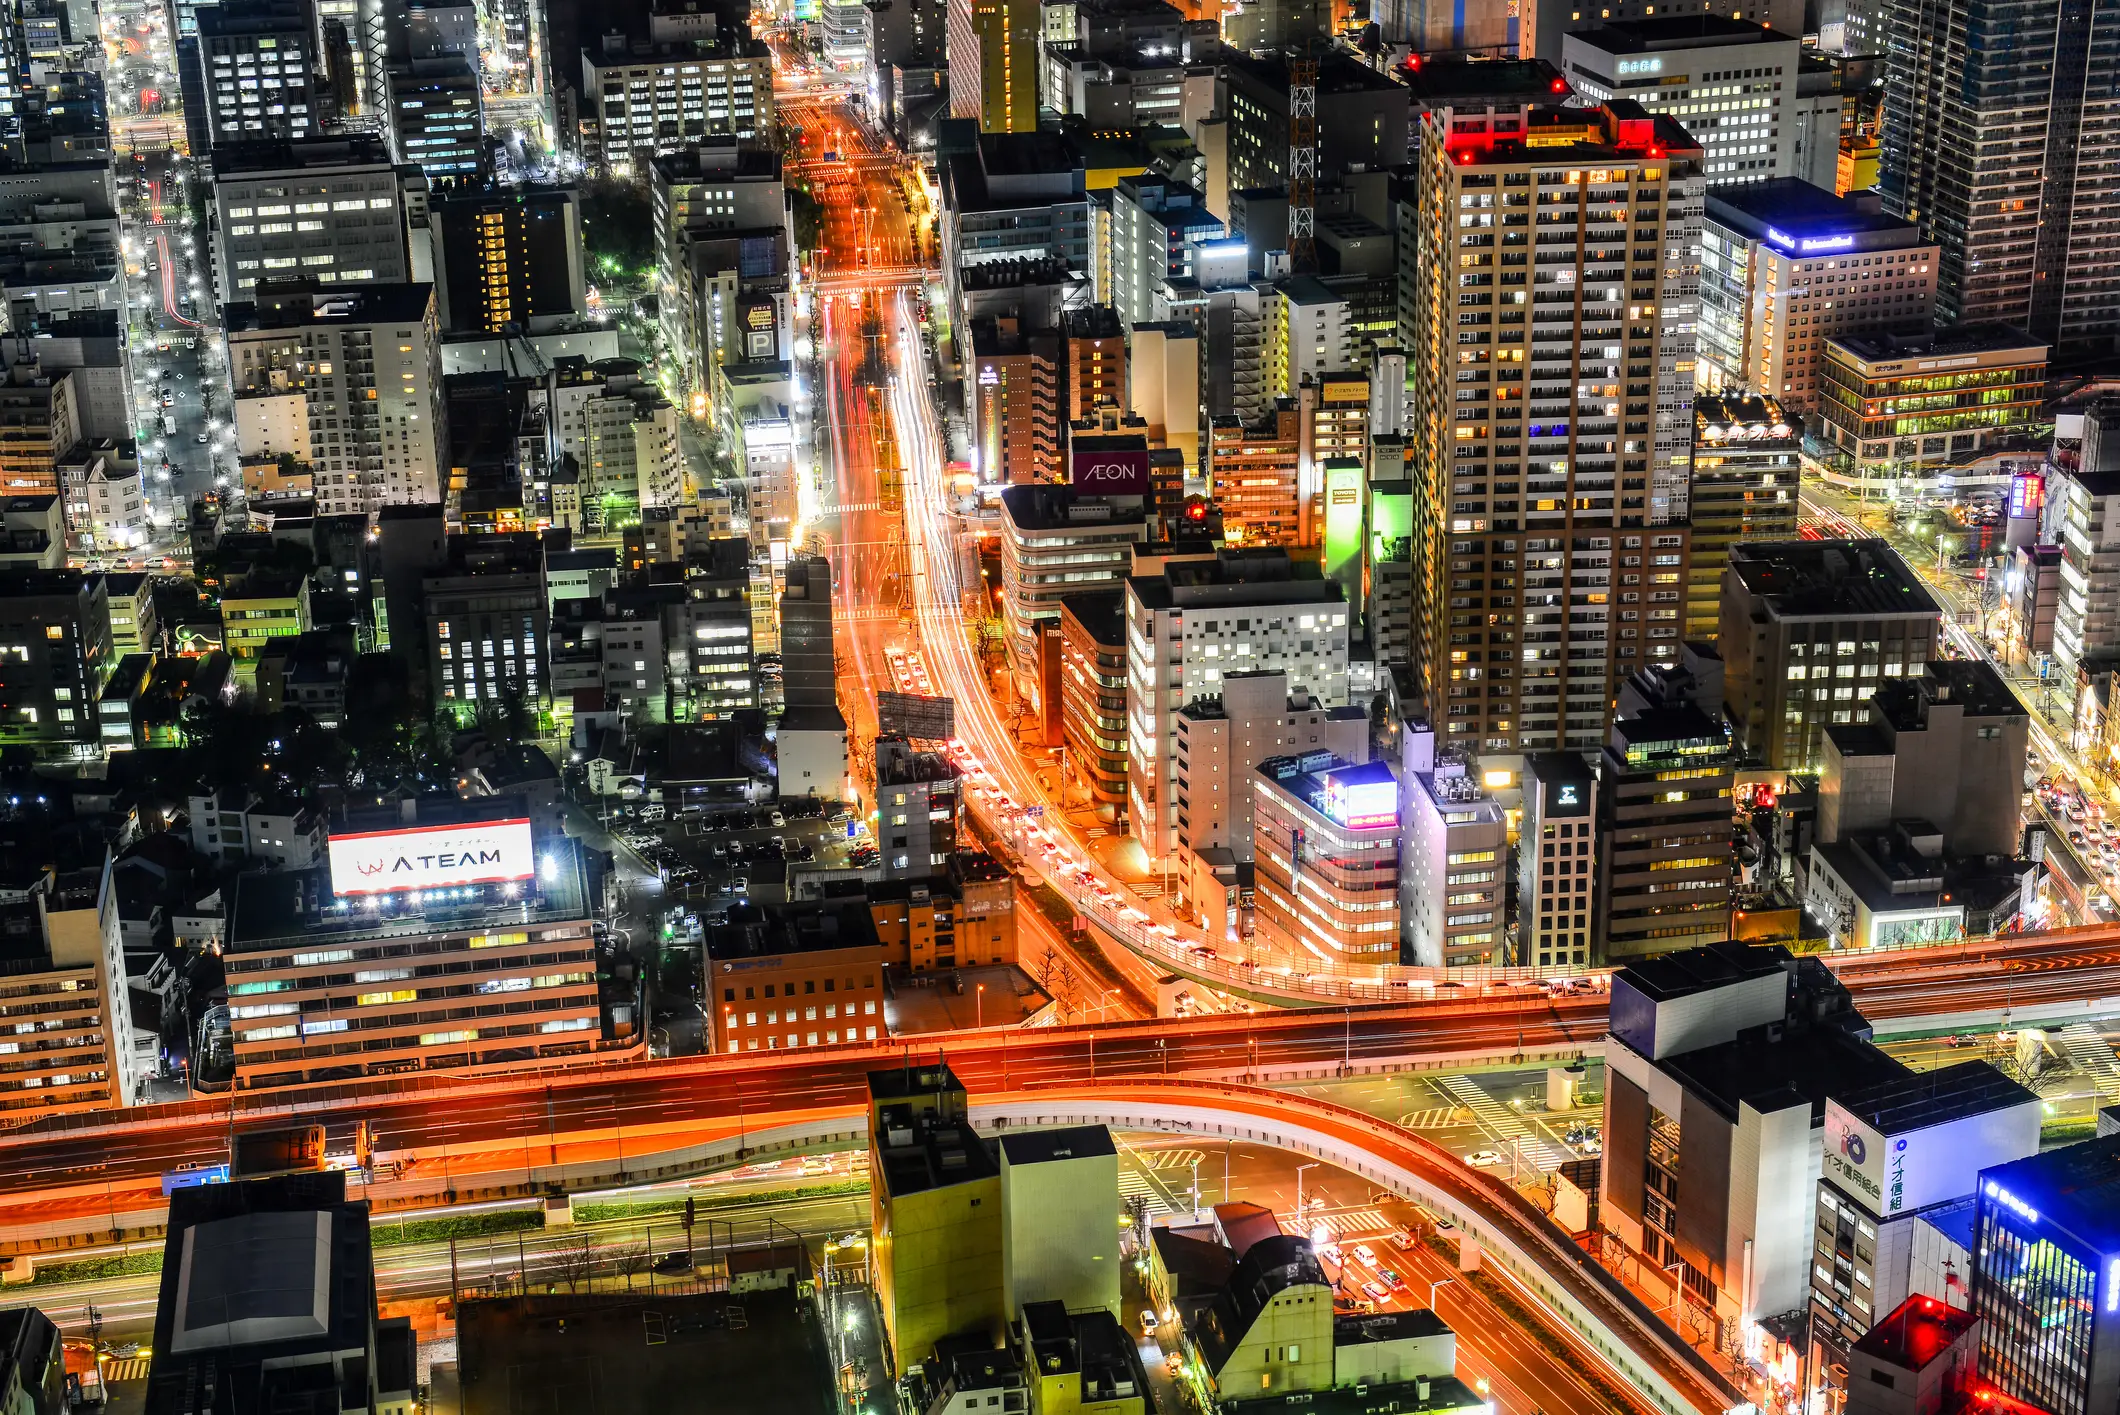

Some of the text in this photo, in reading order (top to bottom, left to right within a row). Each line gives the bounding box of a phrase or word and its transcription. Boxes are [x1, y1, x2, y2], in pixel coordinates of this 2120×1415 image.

[391, 848, 502, 873] ATEAM
[1889, 1154, 1906, 1212] イオ信組
